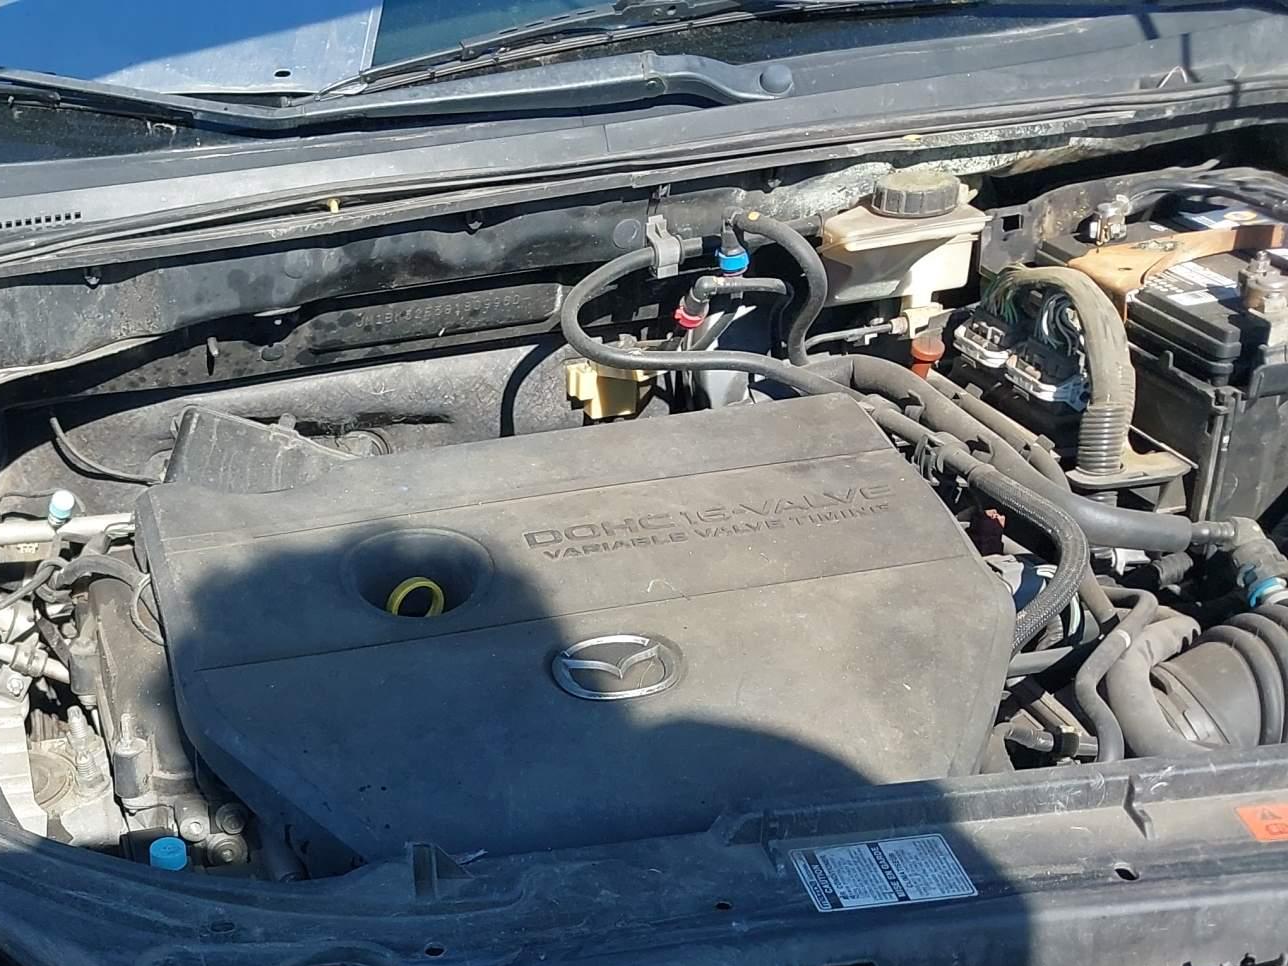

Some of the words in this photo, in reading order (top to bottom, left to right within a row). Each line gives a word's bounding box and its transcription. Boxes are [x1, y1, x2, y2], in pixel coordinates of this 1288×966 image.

[523, 512, 676, 549] DOHC
[679, 485, 896, 525] 16-VALVE
[543, 531, 689, 560] VARIABLE
[694, 520, 785, 539] VALVE
[788, 502, 889, 526] TIMING
[870, 846, 890, 869] GARDE
[811, 864, 833, 894] CAUTION
[884, 870, 897, 880] EN
